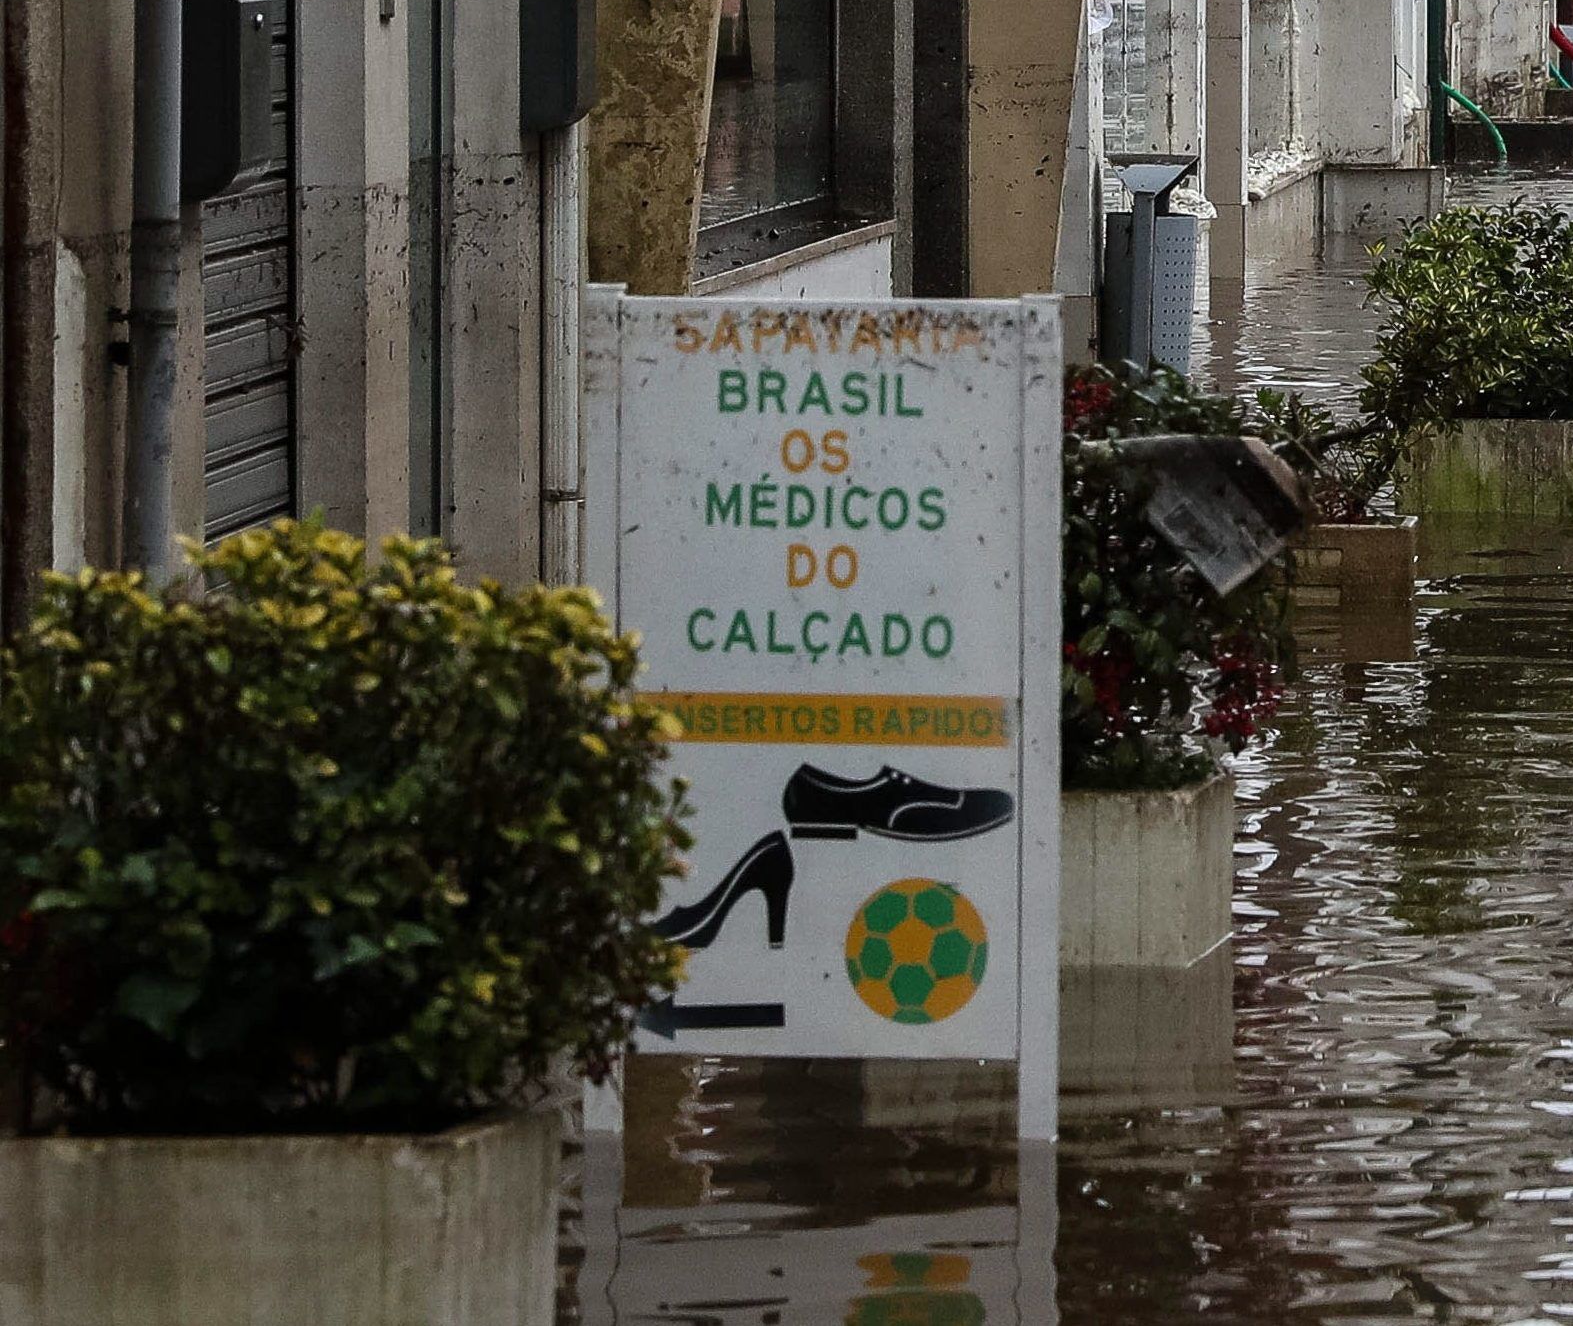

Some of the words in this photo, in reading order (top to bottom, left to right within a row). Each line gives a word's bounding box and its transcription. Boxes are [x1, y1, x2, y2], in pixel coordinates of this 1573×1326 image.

[674, 308, 984, 355] SAPATARIA
[717, 371, 923, 418] BRASIL
[781, 429, 850, 475] OS
[705, 474, 947, 532] MÉDICOS
[787, 544, 859, 590] DO
[687, 607, 954, 665] CALÇADO
[657, 704, 841, 736] NSERTOS
